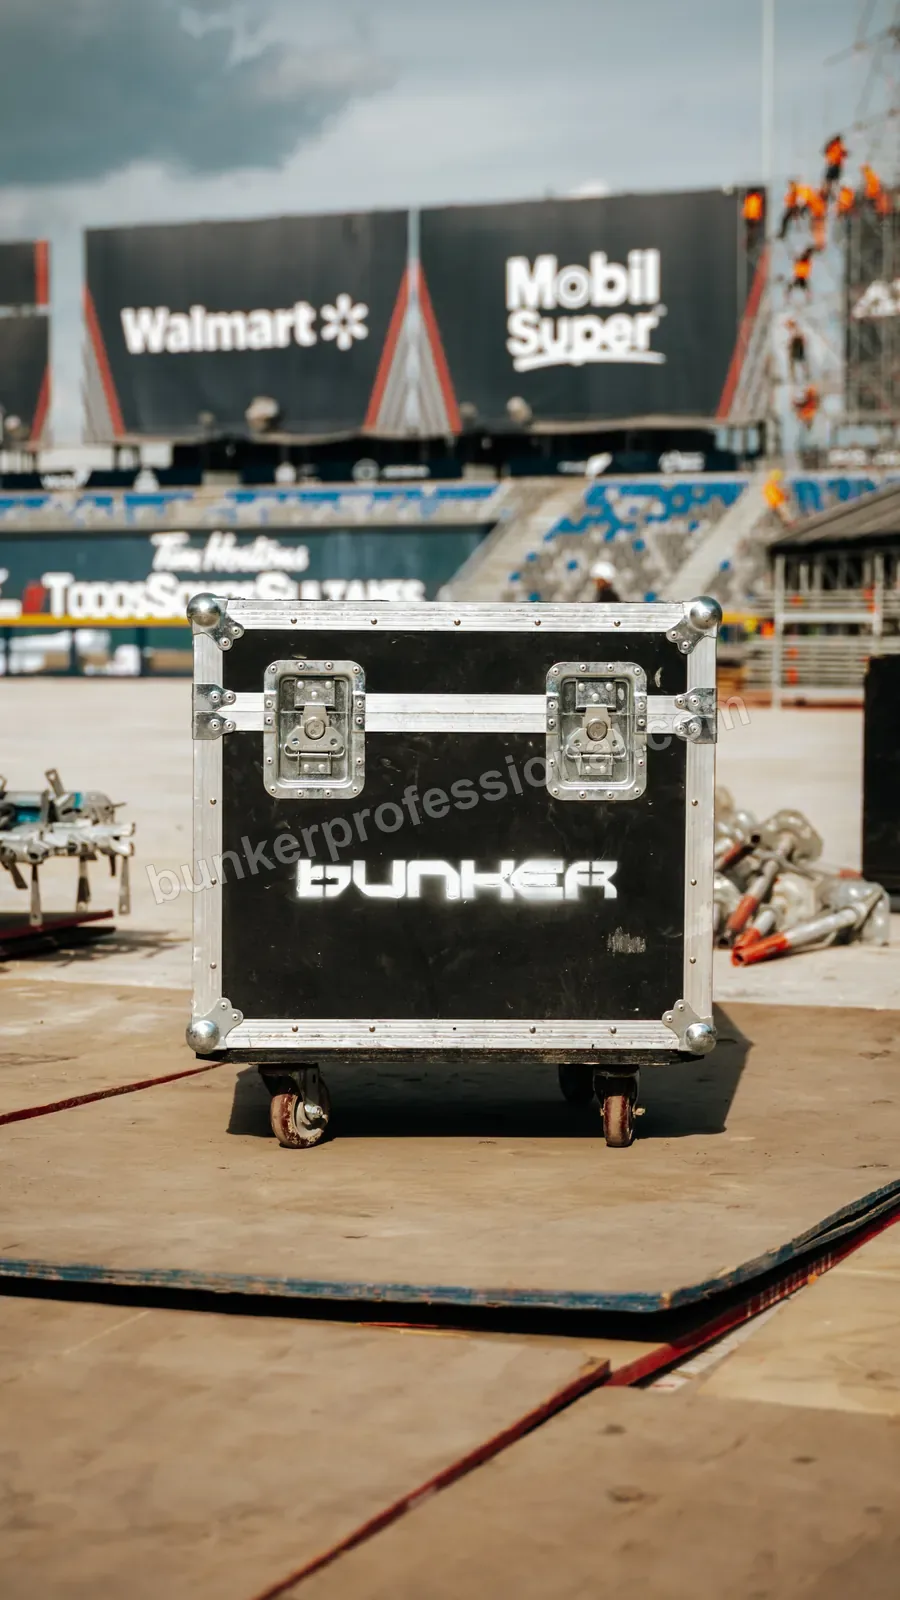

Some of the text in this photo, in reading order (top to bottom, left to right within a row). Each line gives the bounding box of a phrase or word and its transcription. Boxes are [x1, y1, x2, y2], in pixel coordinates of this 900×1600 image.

[505, 248, 661, 310] Mobil
[120, 301, 317, 354] Walmart
[506, 310, 661, 367] Super
